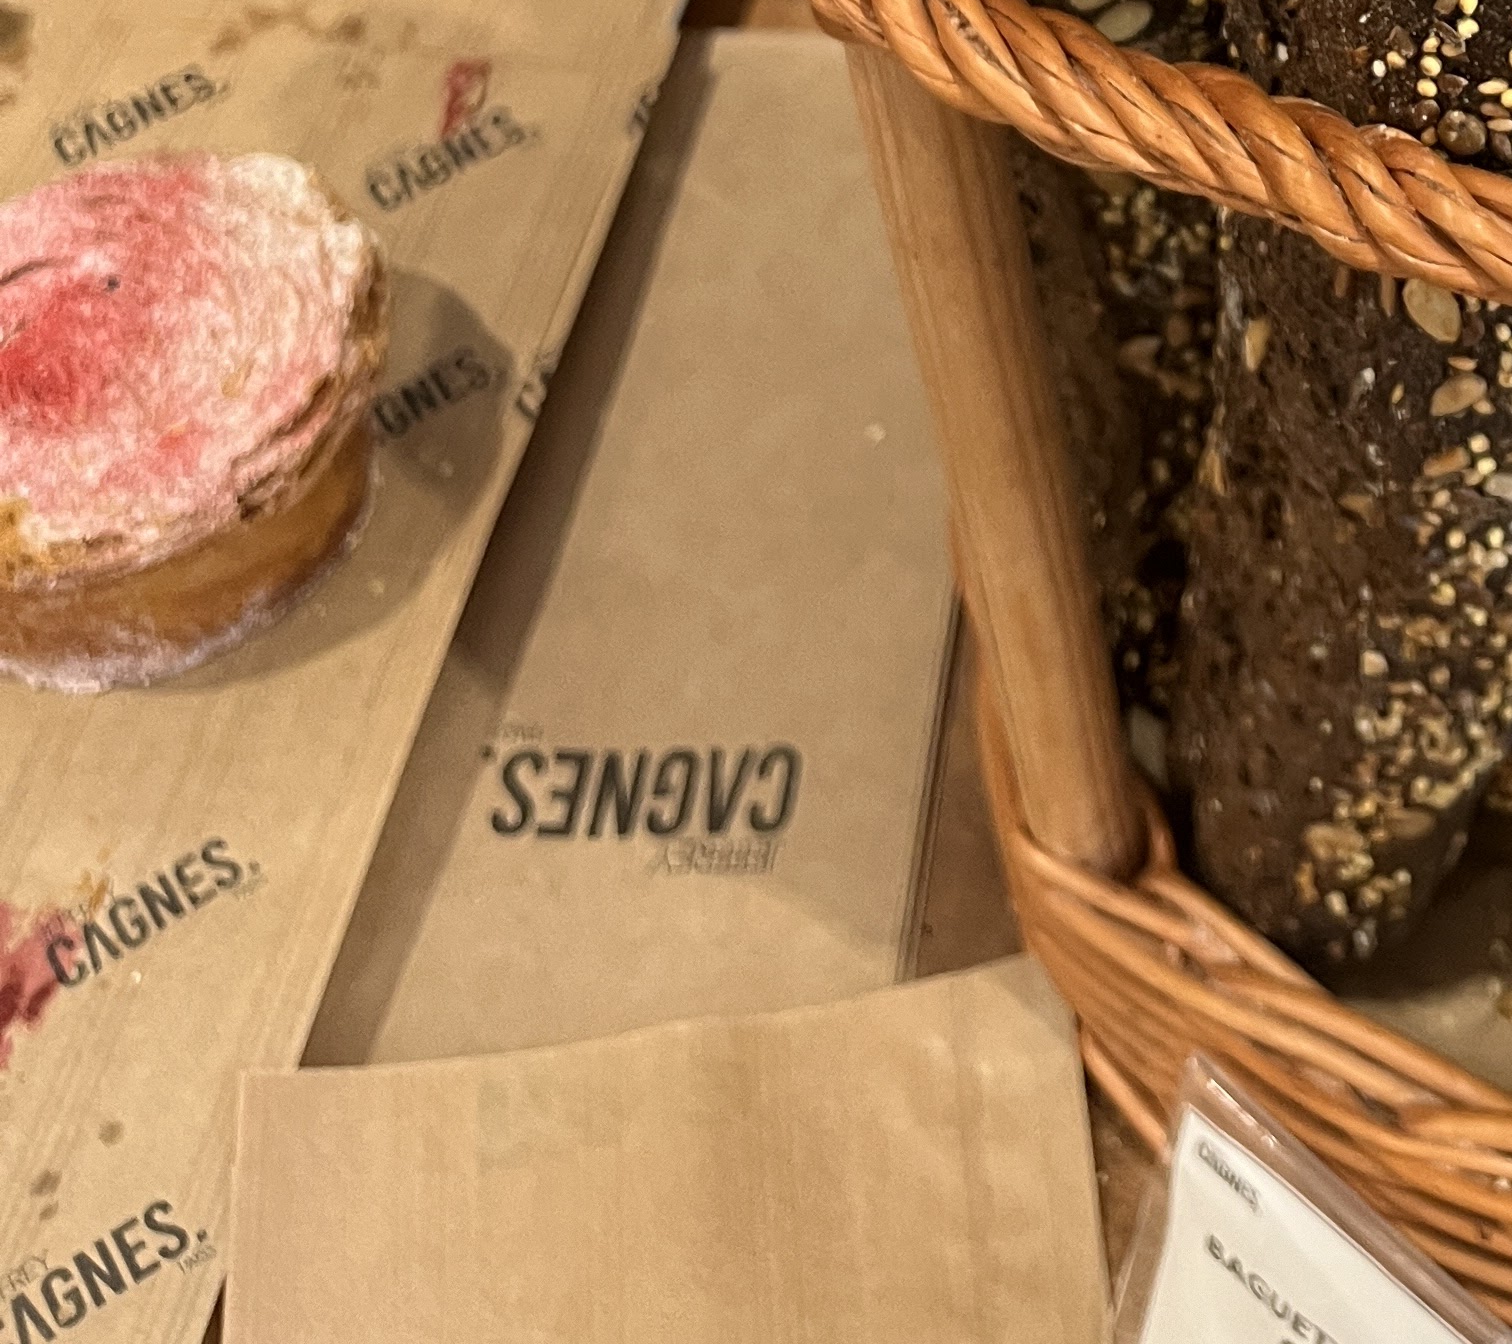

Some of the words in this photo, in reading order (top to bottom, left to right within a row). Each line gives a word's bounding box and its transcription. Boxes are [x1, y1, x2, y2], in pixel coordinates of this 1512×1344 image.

[478, 739, 803, 841] CAGNES.
[46, 835, 262, 989] CAGNES.
[0, 1199, 208, 1344] AGNES.
